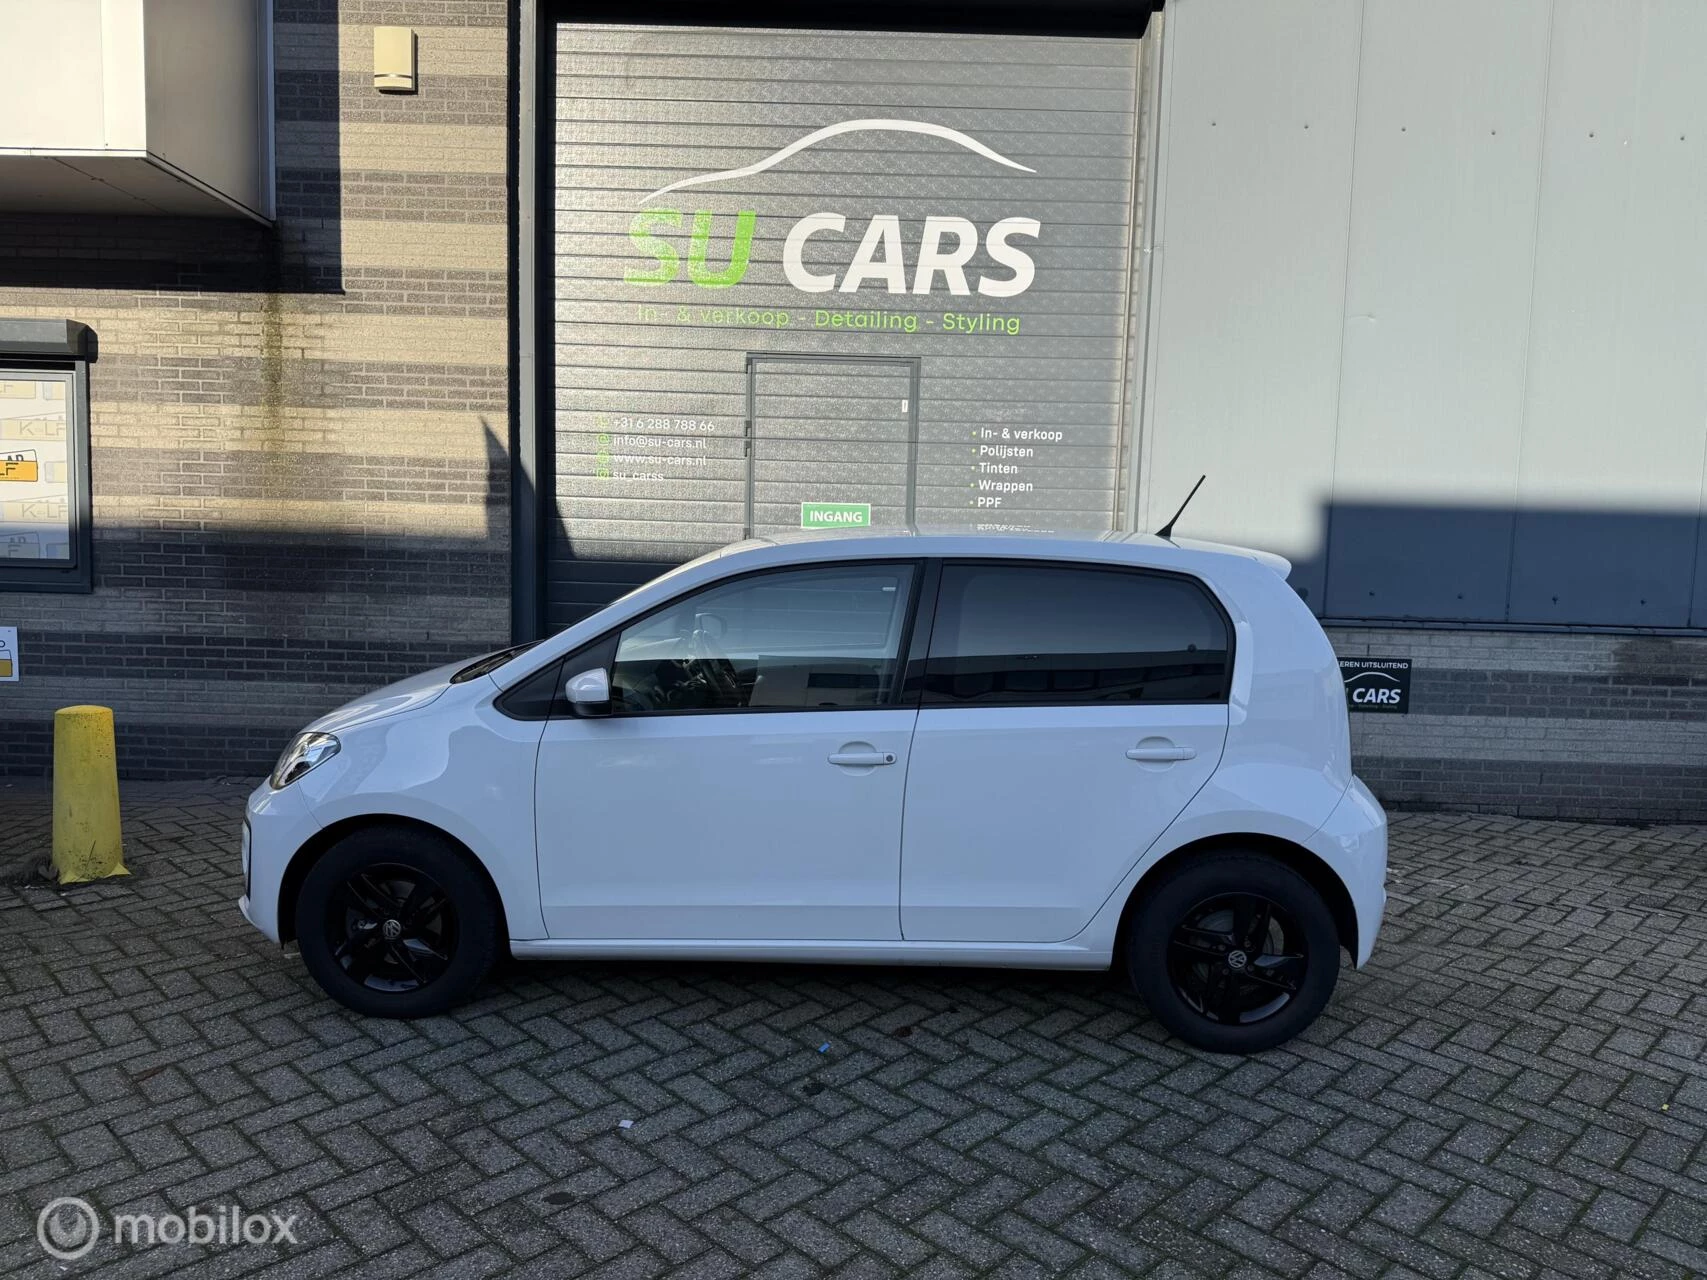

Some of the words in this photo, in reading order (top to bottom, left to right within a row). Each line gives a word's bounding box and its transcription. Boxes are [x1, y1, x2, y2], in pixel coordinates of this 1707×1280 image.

[623, 207, 757, 289] SU
[782, 211, 1042, 298] CARS
[637, 305, 668, 321] In-
[676, 306, 690, 322] &
[700, 307, 789, 328] verkoop
[814, 309, 918, 333] Detailing
[942, 313, 1021, 336] Styling
[613, 417, 633, 428] +31
[636, 419, 644, 429] 6
[647, 418, 671, 430] 288
[674, 419, 697, 431] 788
[699, 420, 715, 432] 66
[613, 434, 707, 449] info@su-cars.nl
[980, 427, 998, 439] In-
[1001, 427, 1011, 439] &
[1013, 428, 1063, 443] verkoop
[980, 445, 1034, 459] Polijsten
[613, 455, 707, 467] www.su-cars.nl
[979, 462, 1018, 474] Tinten
[978, 479, 1034, 494] Wrappen
[977, 496, 1002, 508] PPF
[809, 510, 863, 523] INGANG
[1361, 661, 1409, 669] UITSLUITEND
[1352, 687, 1401, 704] CARS
